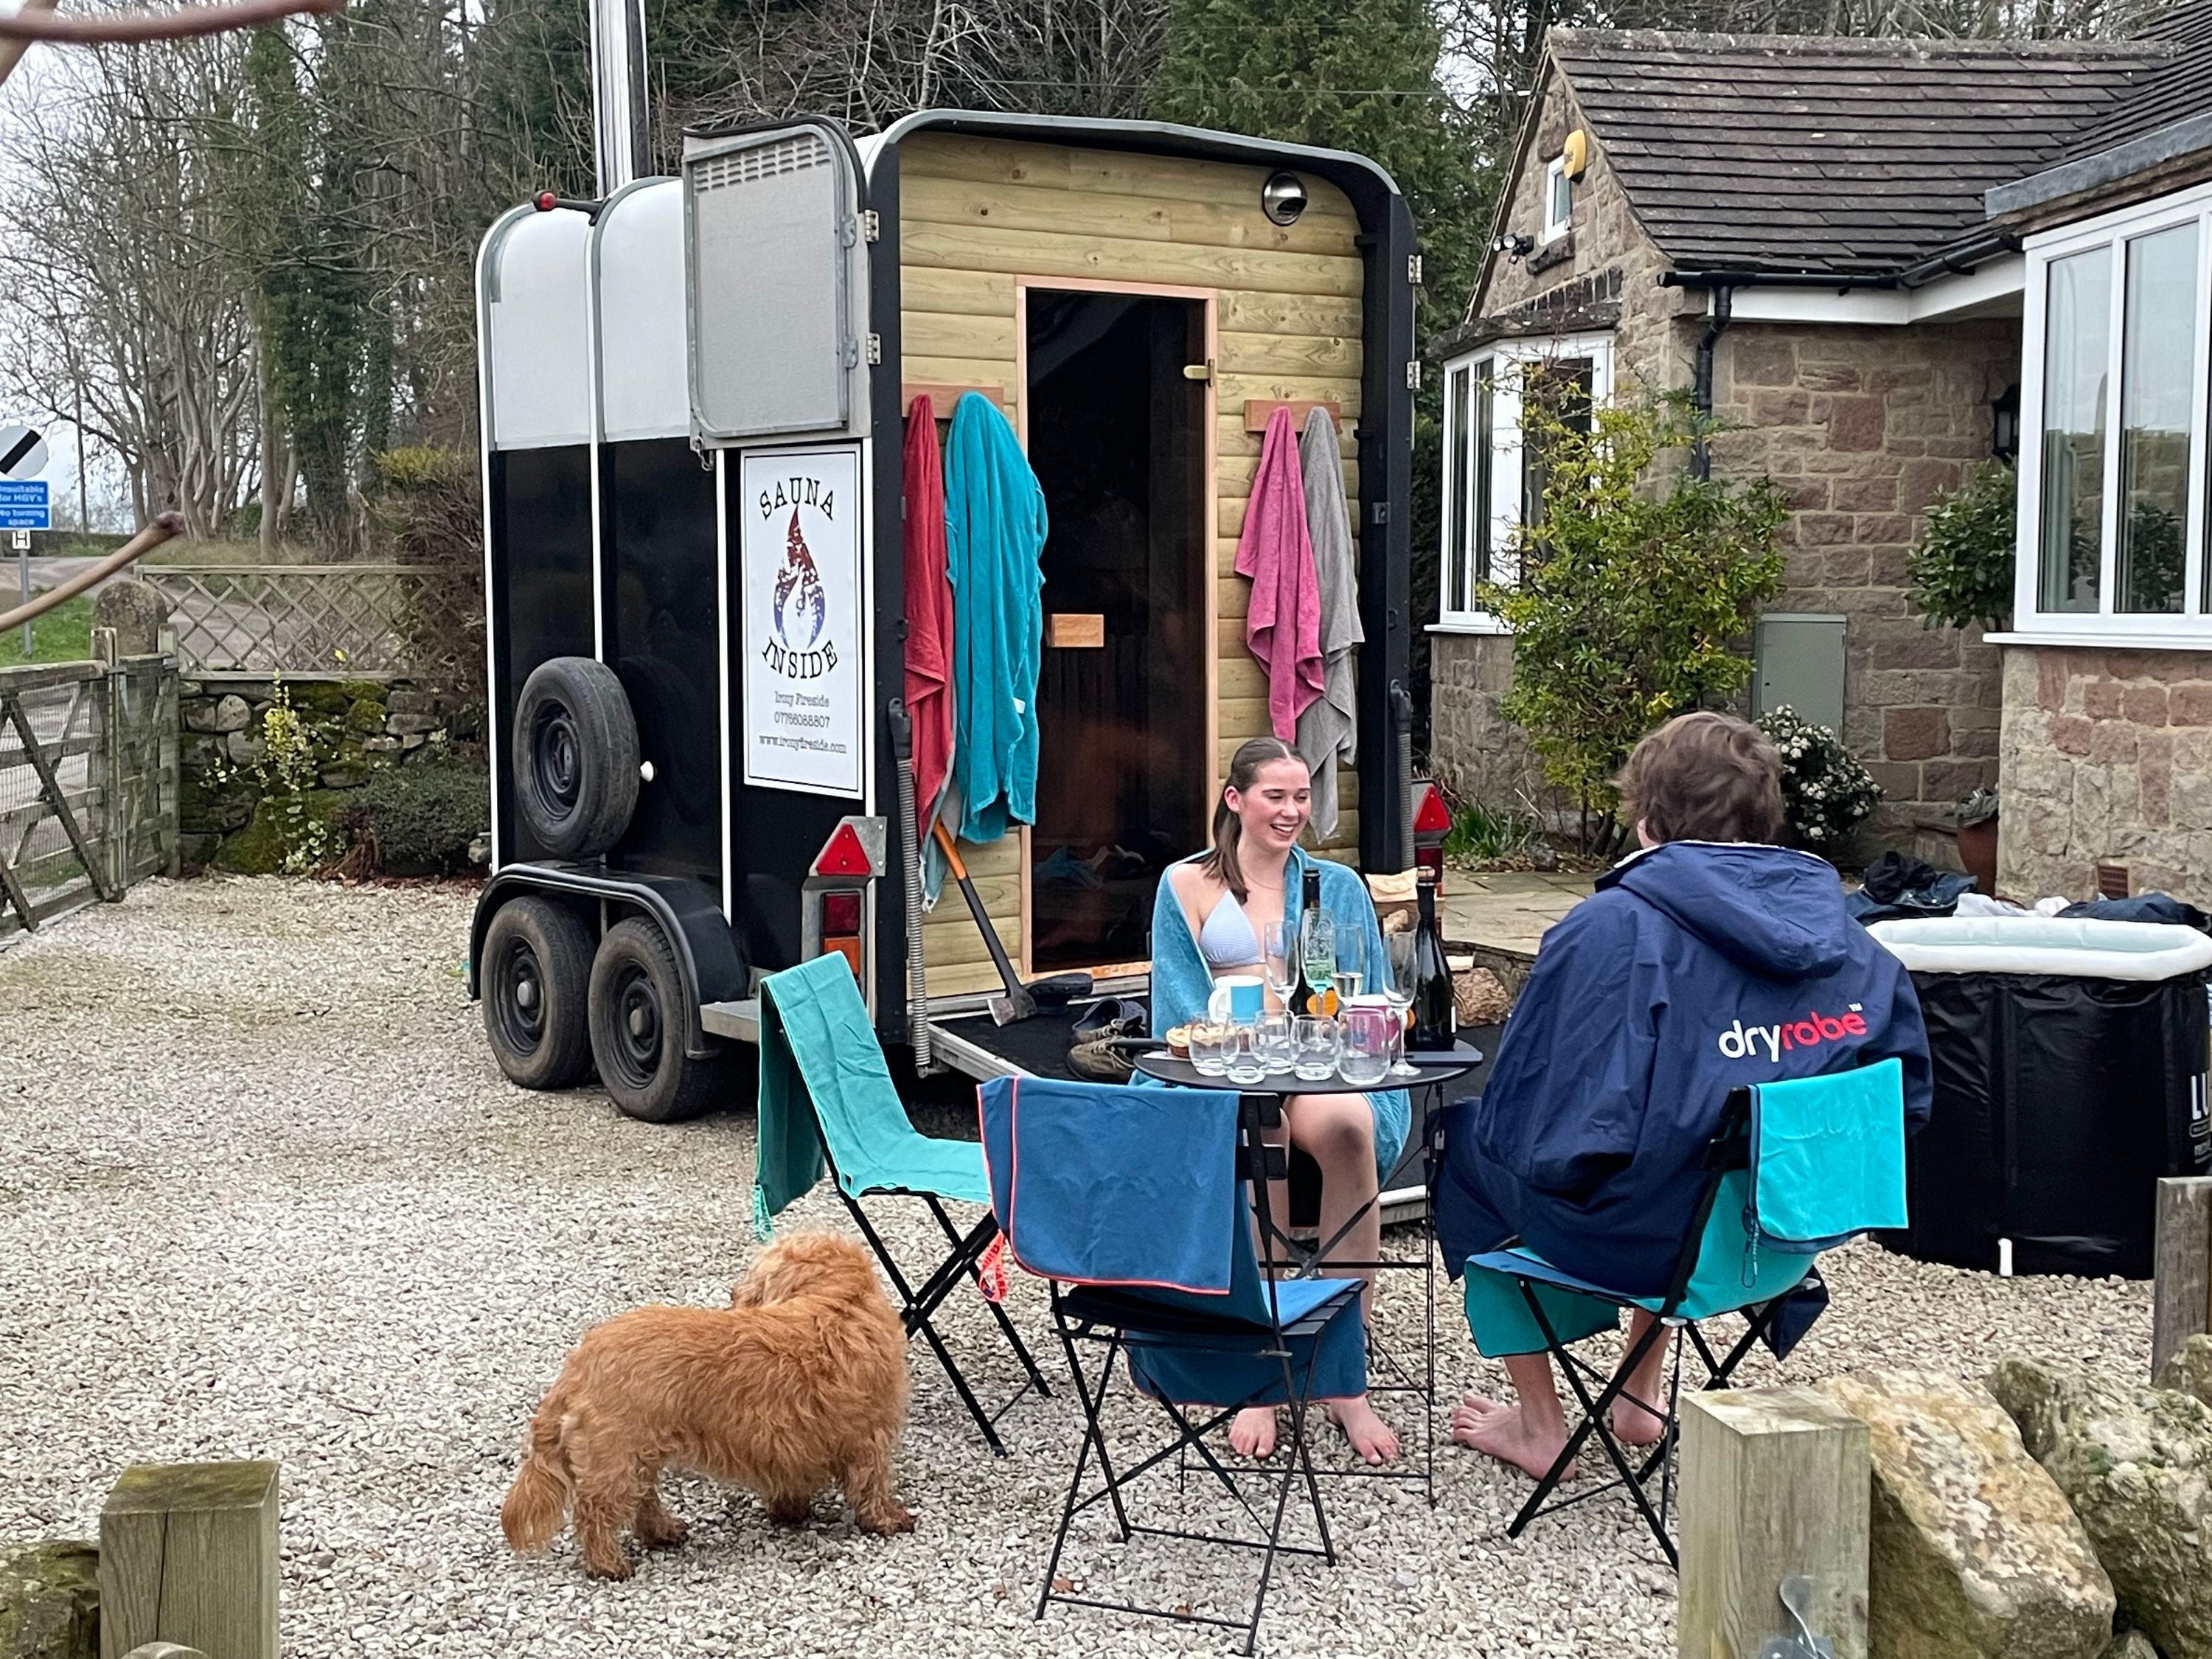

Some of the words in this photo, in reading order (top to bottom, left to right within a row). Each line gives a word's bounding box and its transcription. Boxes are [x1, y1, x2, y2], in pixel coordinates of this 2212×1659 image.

[13, 509, 45, 518] turning
[759, 477, 833, 521] SAUNA
[762, 636, 838, 679] INSIDE
[796, 692, 830, 708] Fireside
